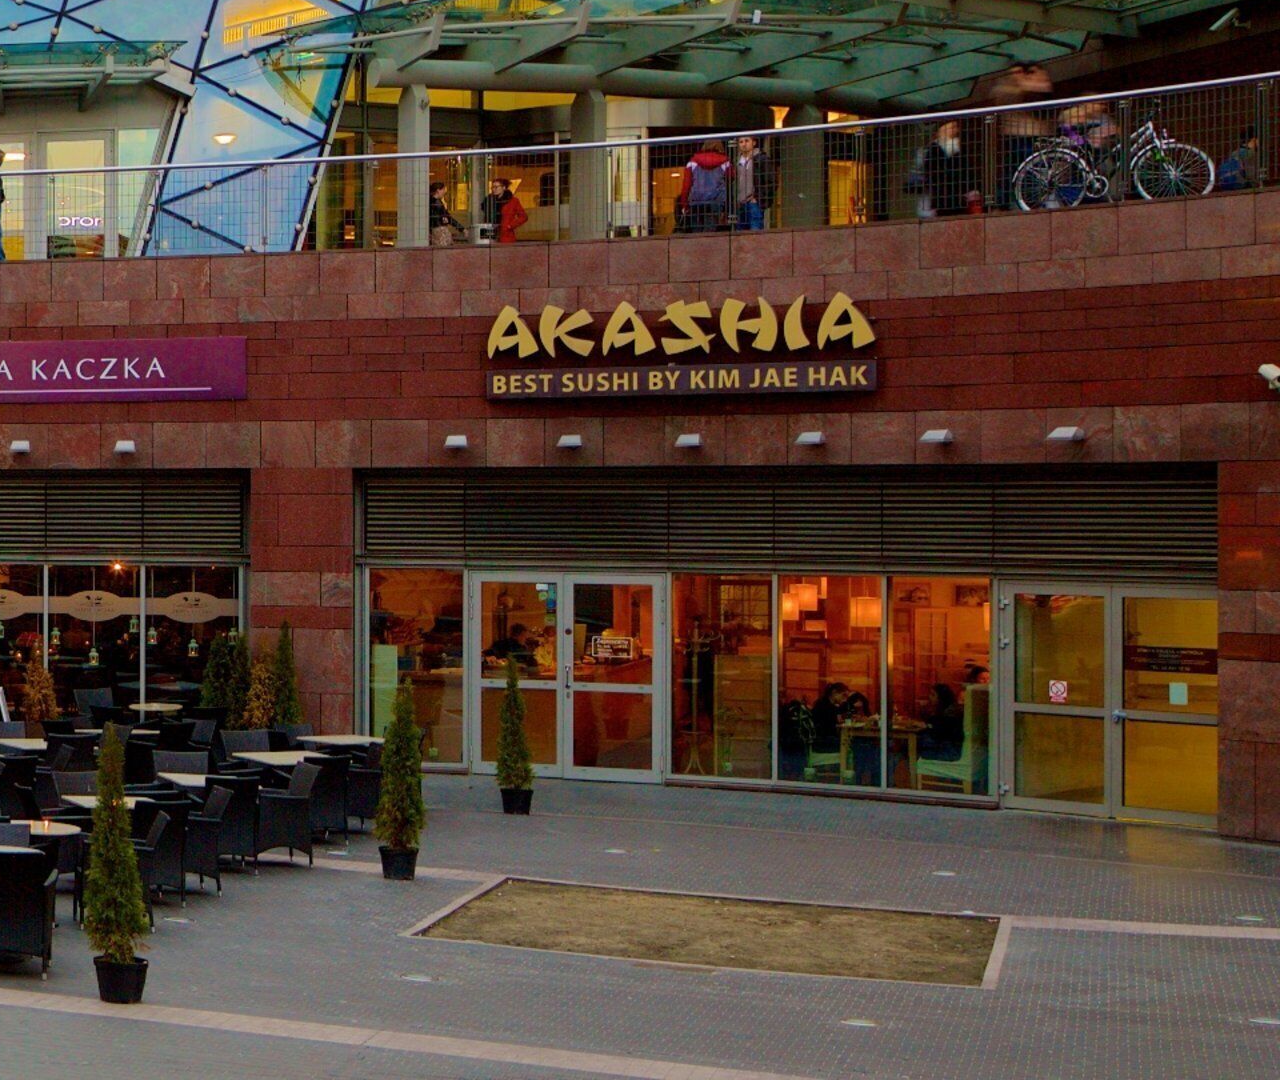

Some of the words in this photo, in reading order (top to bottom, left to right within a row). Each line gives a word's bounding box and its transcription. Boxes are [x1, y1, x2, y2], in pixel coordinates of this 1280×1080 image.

[487, 291, 876, 359] AKASHIA
[31, 356, 166, 382] KACZKA
[493, 373, 553, 394] BEST
[561, 371, 639, 393] SUSHI
[648, 370, 681, 391] BY
[690, 368, 740, 389] KIM
[749, 367, 799, 388] JAE
[808, 365, 869, 386] HAK
